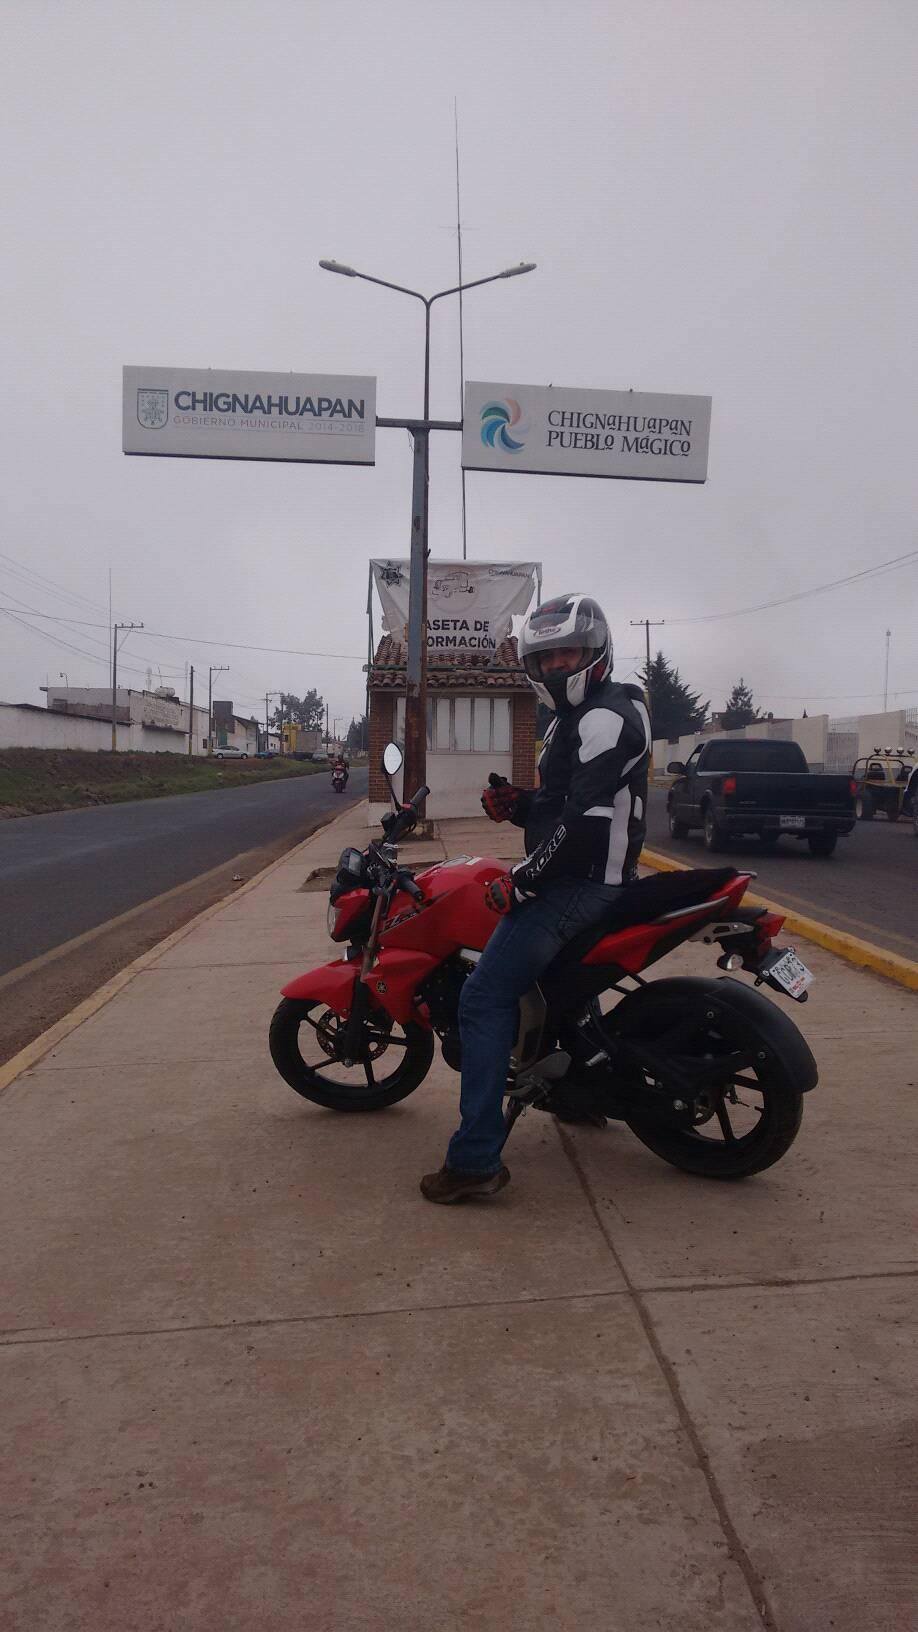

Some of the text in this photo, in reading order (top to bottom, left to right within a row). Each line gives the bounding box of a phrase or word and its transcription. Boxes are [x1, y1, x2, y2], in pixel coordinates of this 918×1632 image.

[174, 391, 365, 419] CHIGNAHUAPAN
[173, 415, 236, 427] GOBIERNO
[240, 419, 301, 431] MUNICIPAL
[427, 619, 490, 632] ASETA DE
[427, 634, 496, 649] ORMACIÓN
